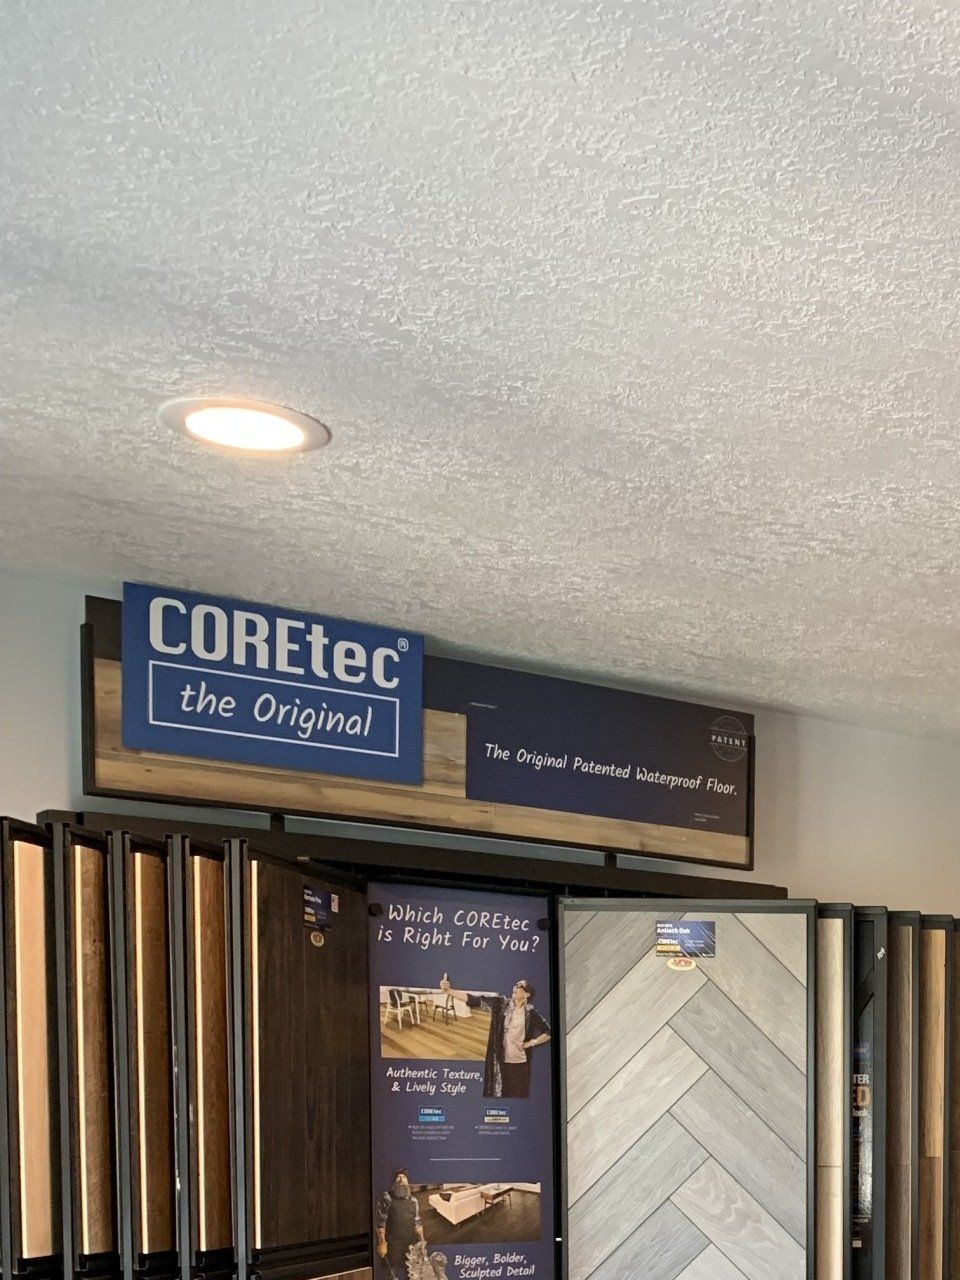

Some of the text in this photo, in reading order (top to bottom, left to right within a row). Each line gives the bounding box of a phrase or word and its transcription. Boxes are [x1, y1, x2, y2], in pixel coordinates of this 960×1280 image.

[180, 681, 372, 738] the Original
[711, 735, 746, 747] PATENT
[485, 743, 738, 796] The Original Patented Waterproof Floor.
[388, 904, 530, 931] Which COREtec
[377, 925, 540, 952] is Right For You?
[386, 1066, 483, 1082] Authentic Texture,
[391, 1081, 467, 1096] & Lively Style
[454, 1252, 527, 1268] Bigger, Bolder,
[459, 1264, 536, 1280] Sculpted Detail
